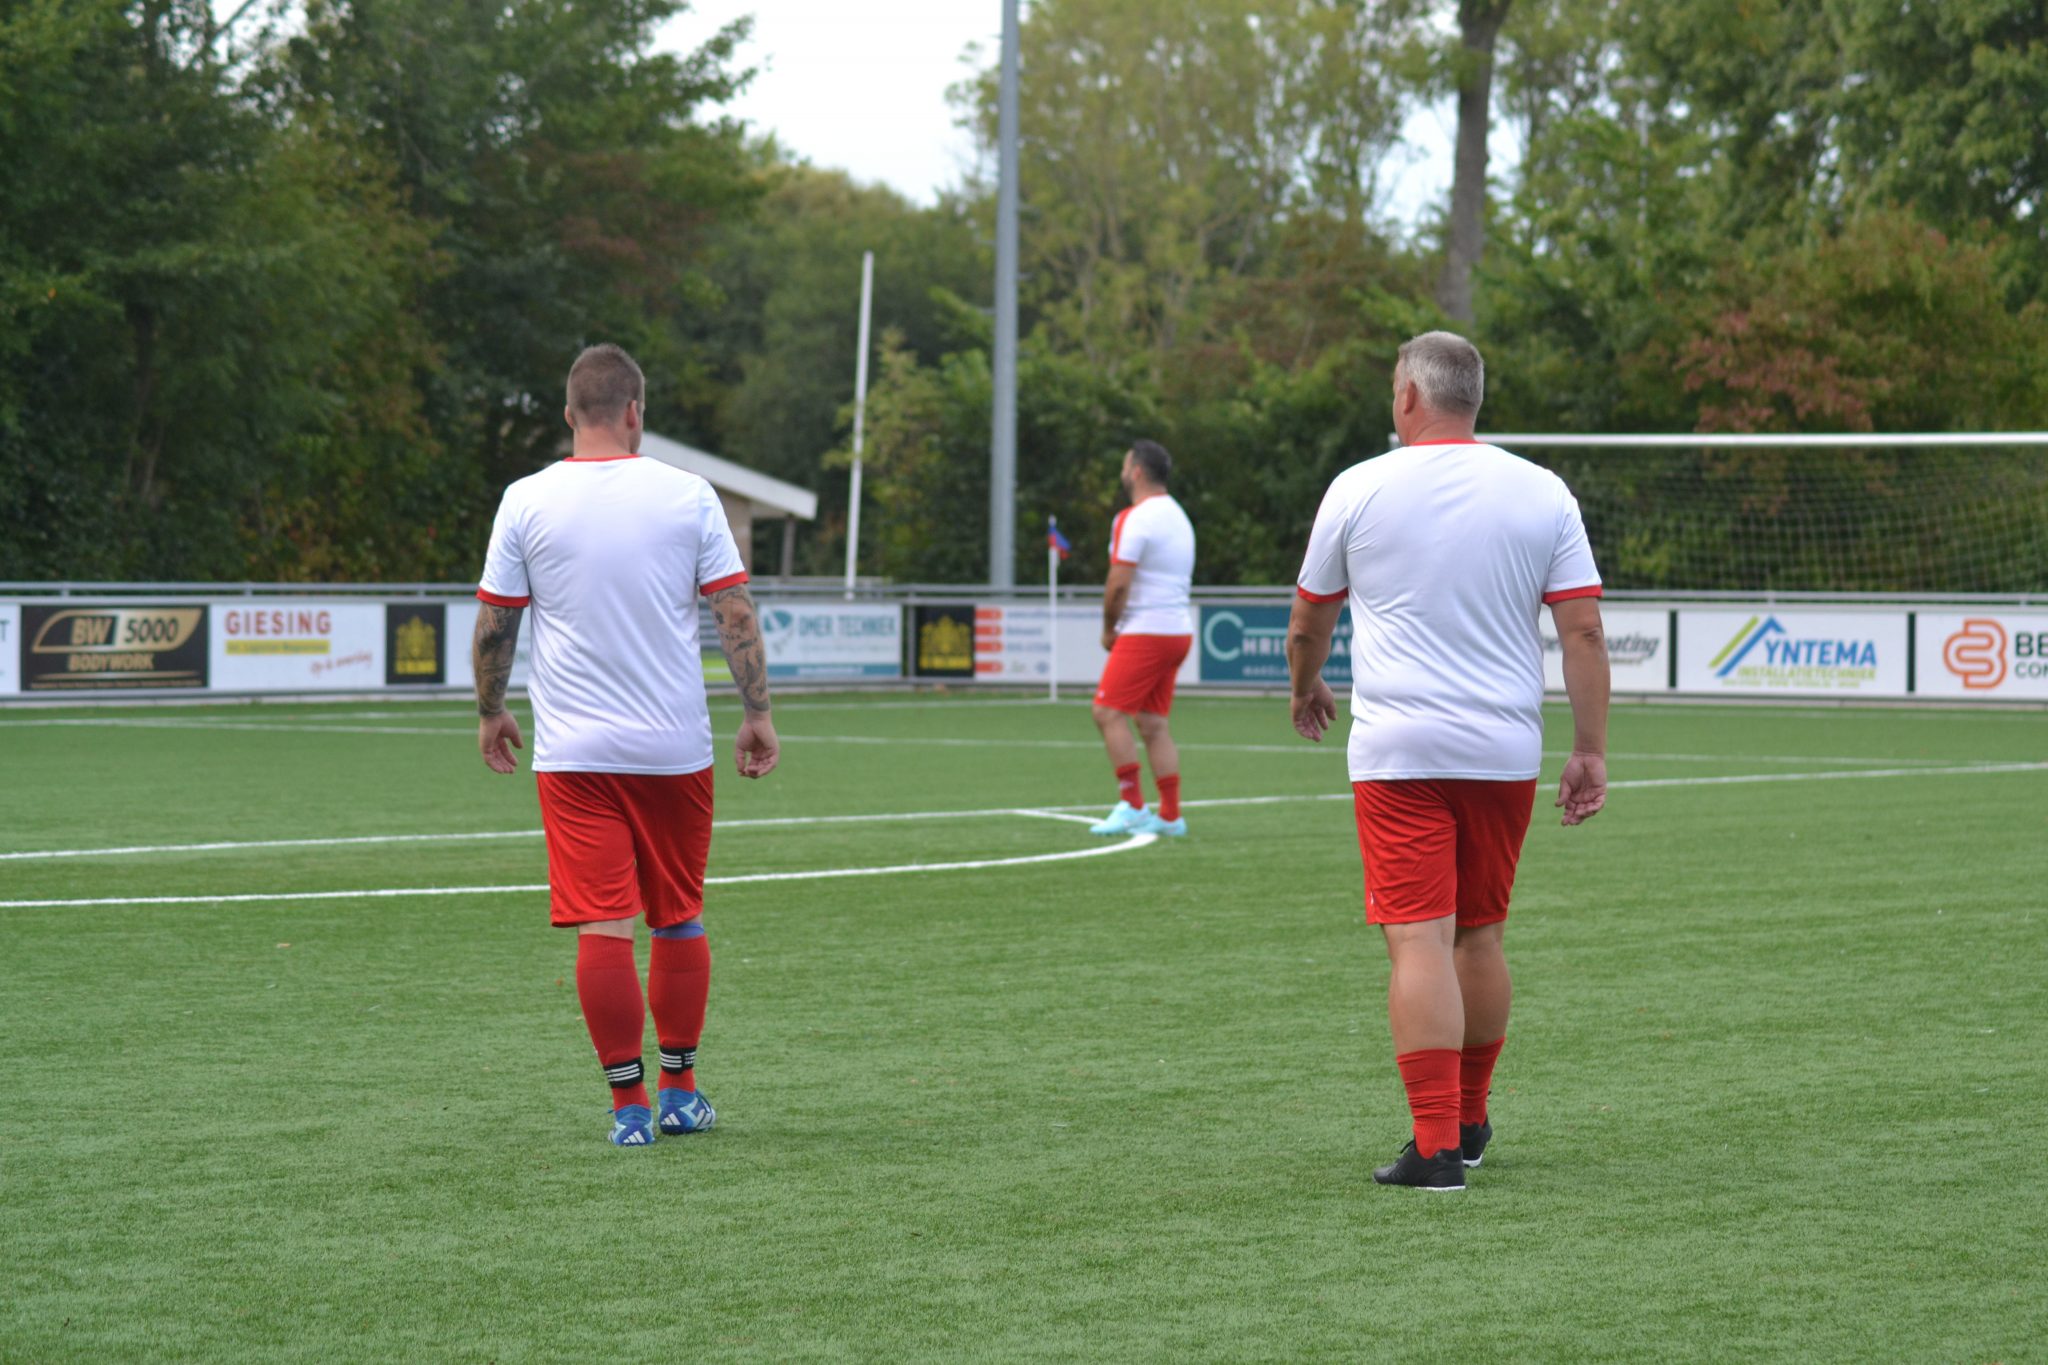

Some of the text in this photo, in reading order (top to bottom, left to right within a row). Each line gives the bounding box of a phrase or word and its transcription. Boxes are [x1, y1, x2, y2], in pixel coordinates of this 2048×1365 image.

[70, 616, 179, 645] BW 5000
[225, 611, 332, 635] GIESING
[67, 651, 154, 672] BODYWORK
[1764, 639, 1878, 667] YNTEMA
